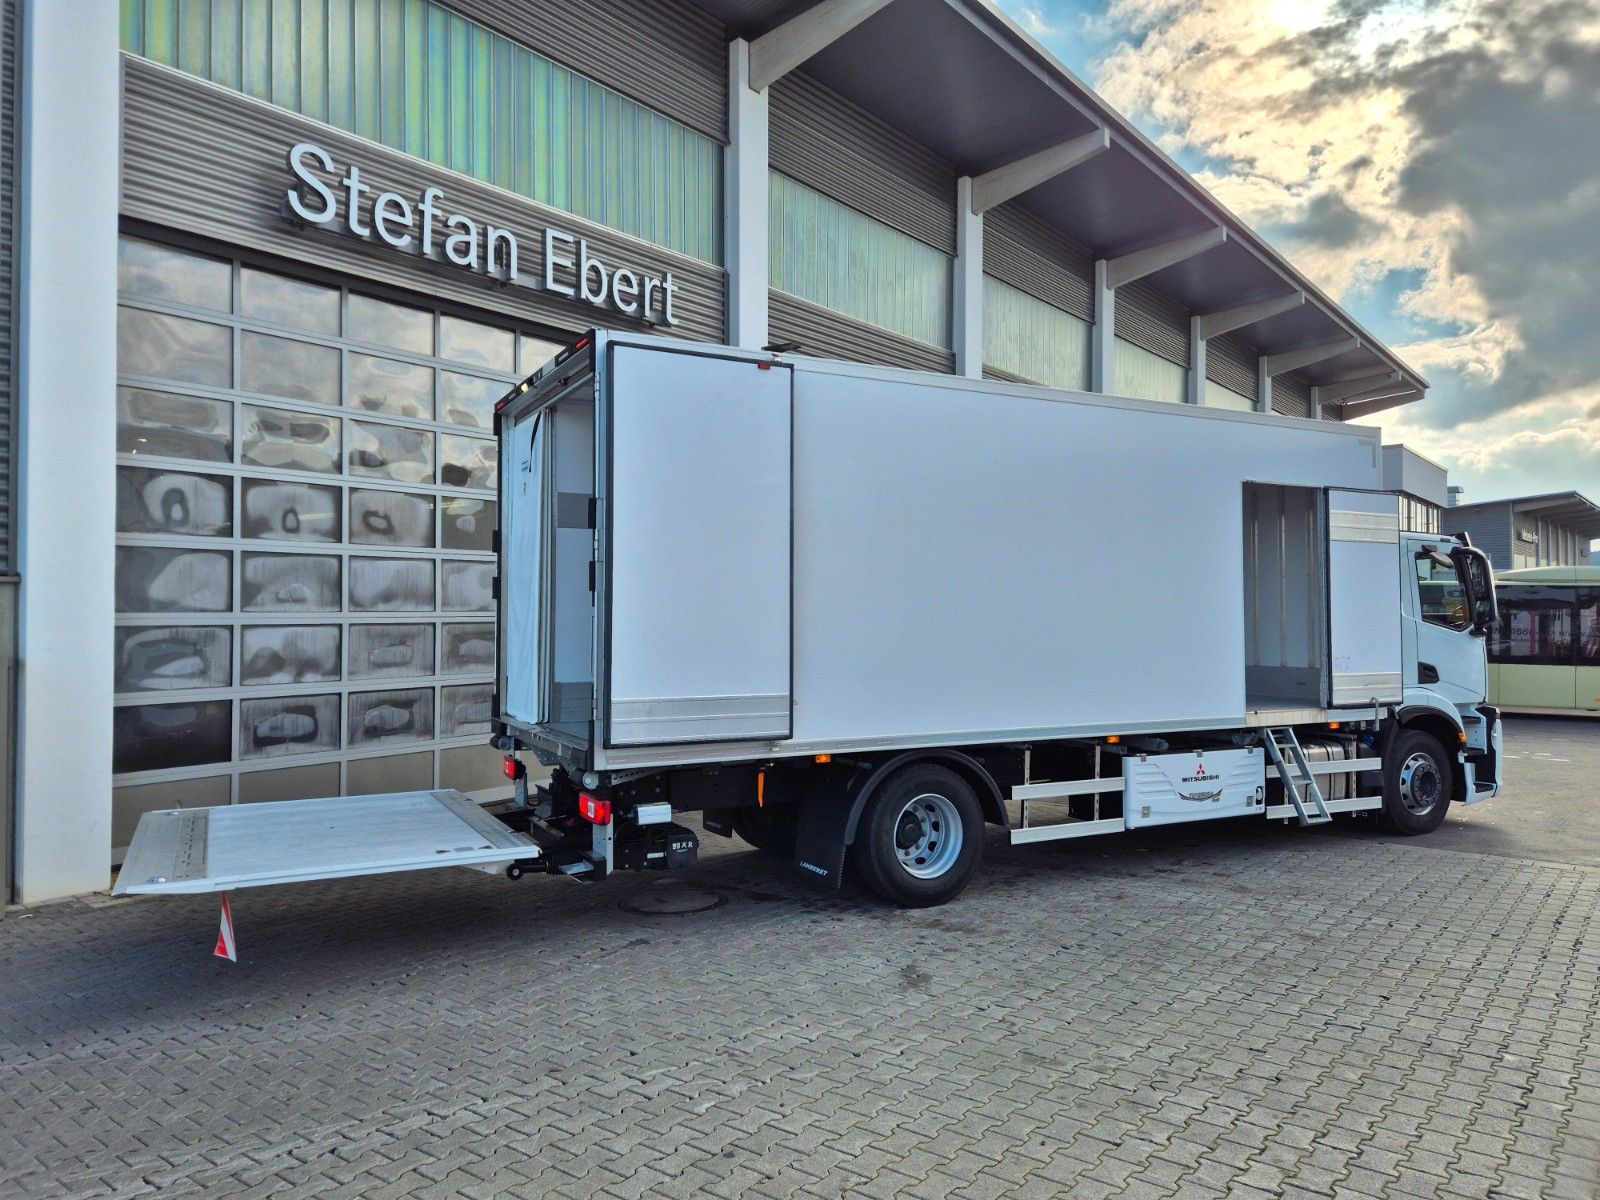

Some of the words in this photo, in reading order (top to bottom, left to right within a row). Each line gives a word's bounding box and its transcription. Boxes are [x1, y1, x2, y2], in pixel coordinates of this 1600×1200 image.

[287, 142, 518, 281] Stefan
[544, 227, 679, 325] Ebert
[1182, 774, 1220, 783] MITSUBISHI
[800, 860, 829, 876] LAMBERET
